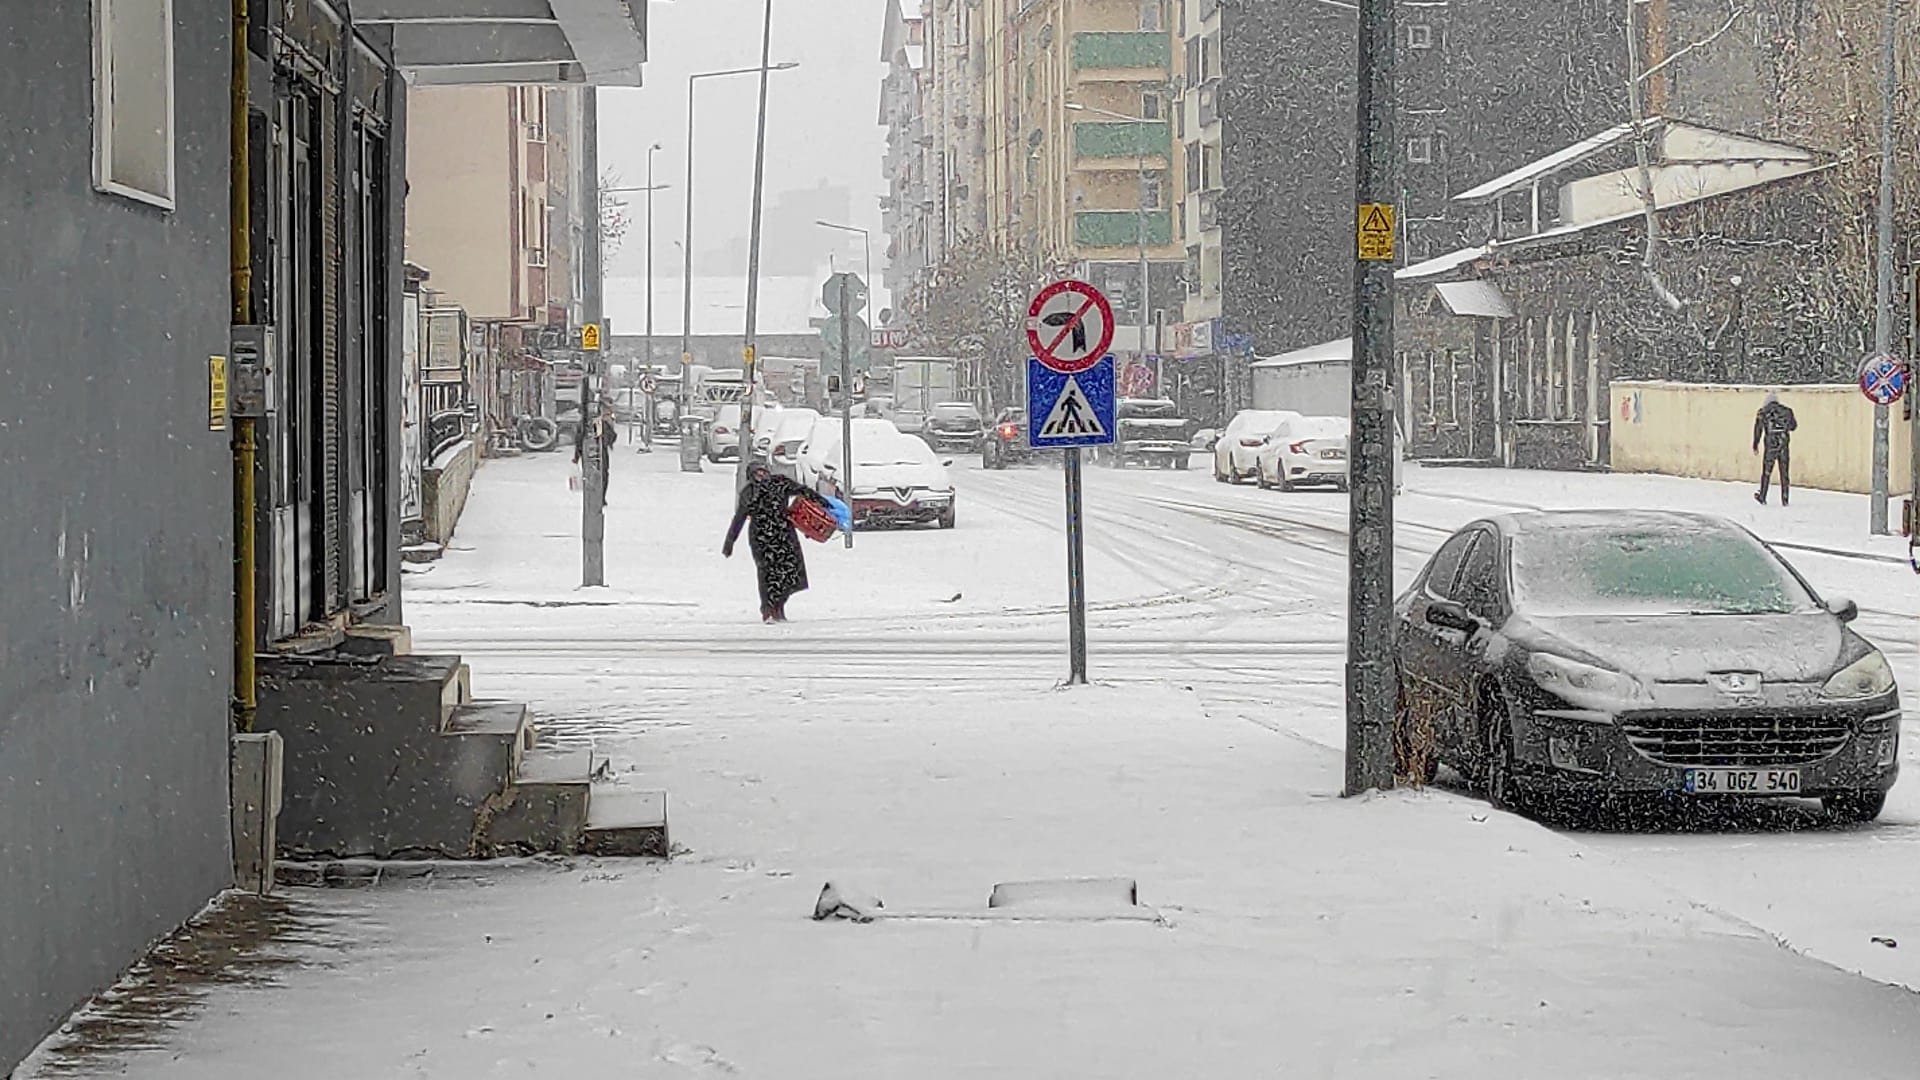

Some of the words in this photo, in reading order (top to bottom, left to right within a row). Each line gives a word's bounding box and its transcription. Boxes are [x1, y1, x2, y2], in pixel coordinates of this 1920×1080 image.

[1697, 772, 1717, 790] 34
[1727, 772, 1757, 790] DGZ
[1767, 772, 1799, 790] 540
